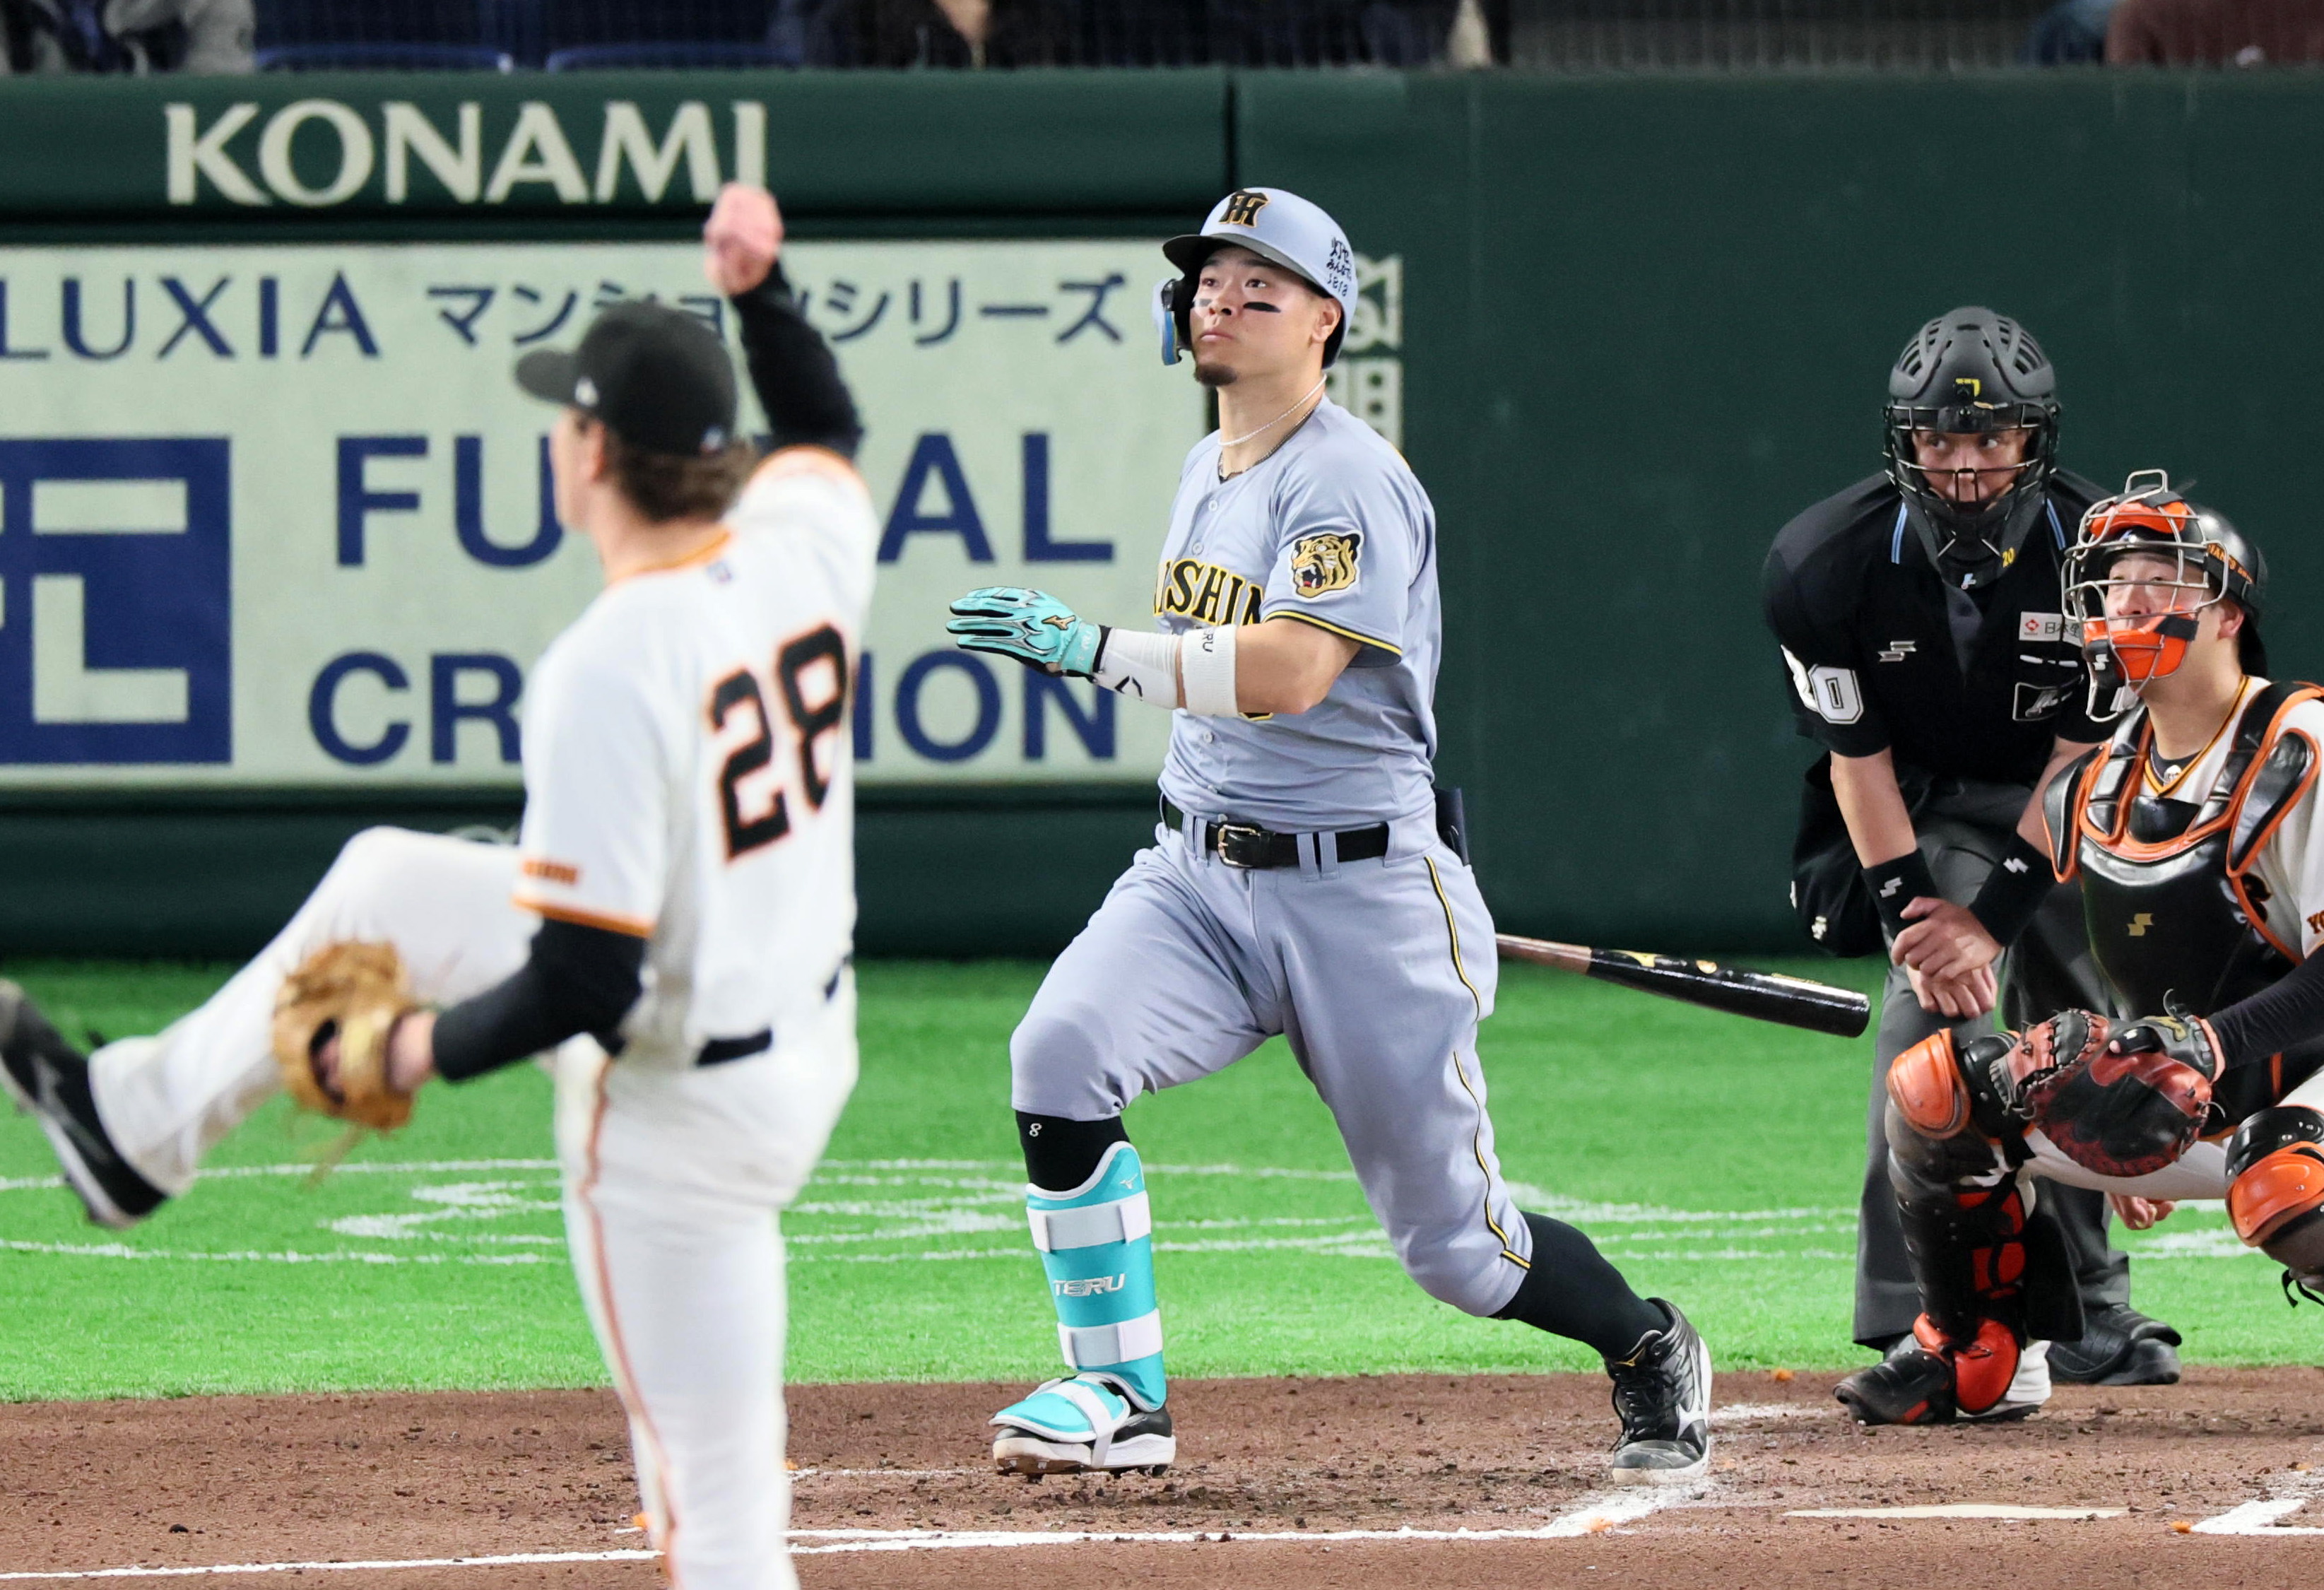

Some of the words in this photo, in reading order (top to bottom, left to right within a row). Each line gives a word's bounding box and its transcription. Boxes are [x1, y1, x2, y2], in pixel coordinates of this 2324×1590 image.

[165, 99, 767, 206] KONAMI
[427, 273, 1125, 346] マンシリーズ
[336, 432, 1114, 567] FUAL
[309, 649, 1115, 766] CRION
[708, 622, 847, 859] 28
[1029, 1123, 1042, 1137] 8
[1053, 1273, 1126, 1297] TERU
